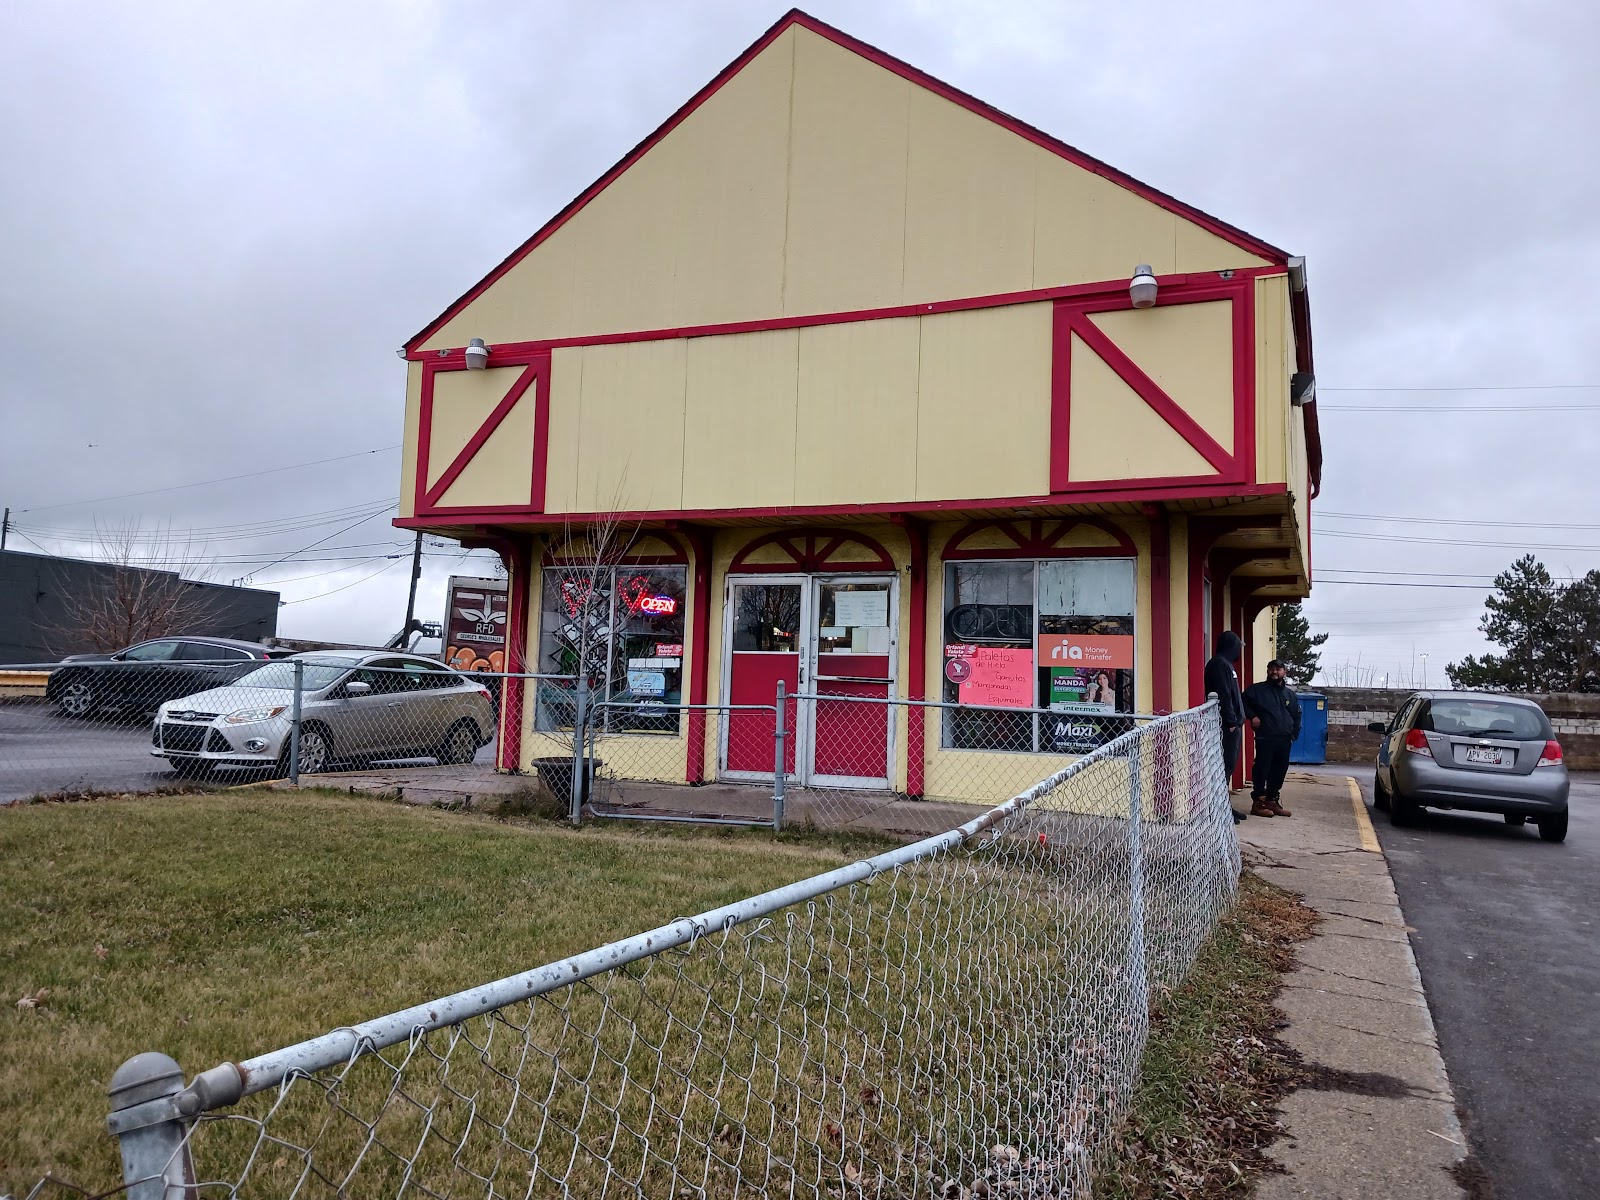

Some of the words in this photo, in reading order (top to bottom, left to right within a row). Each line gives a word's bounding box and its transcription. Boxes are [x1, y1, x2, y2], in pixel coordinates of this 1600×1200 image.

[641, 597, 675, 612] OPEN
[475, 622, 495, 634] RFD
[1052, 639, 1082, 659] ria
[1085, 646, 1108, 654] Money
[981, 650, 1014, 662] Paletas
[975, 659, 985, 667] de
[1055, 722, 1093, 736] Maxi
